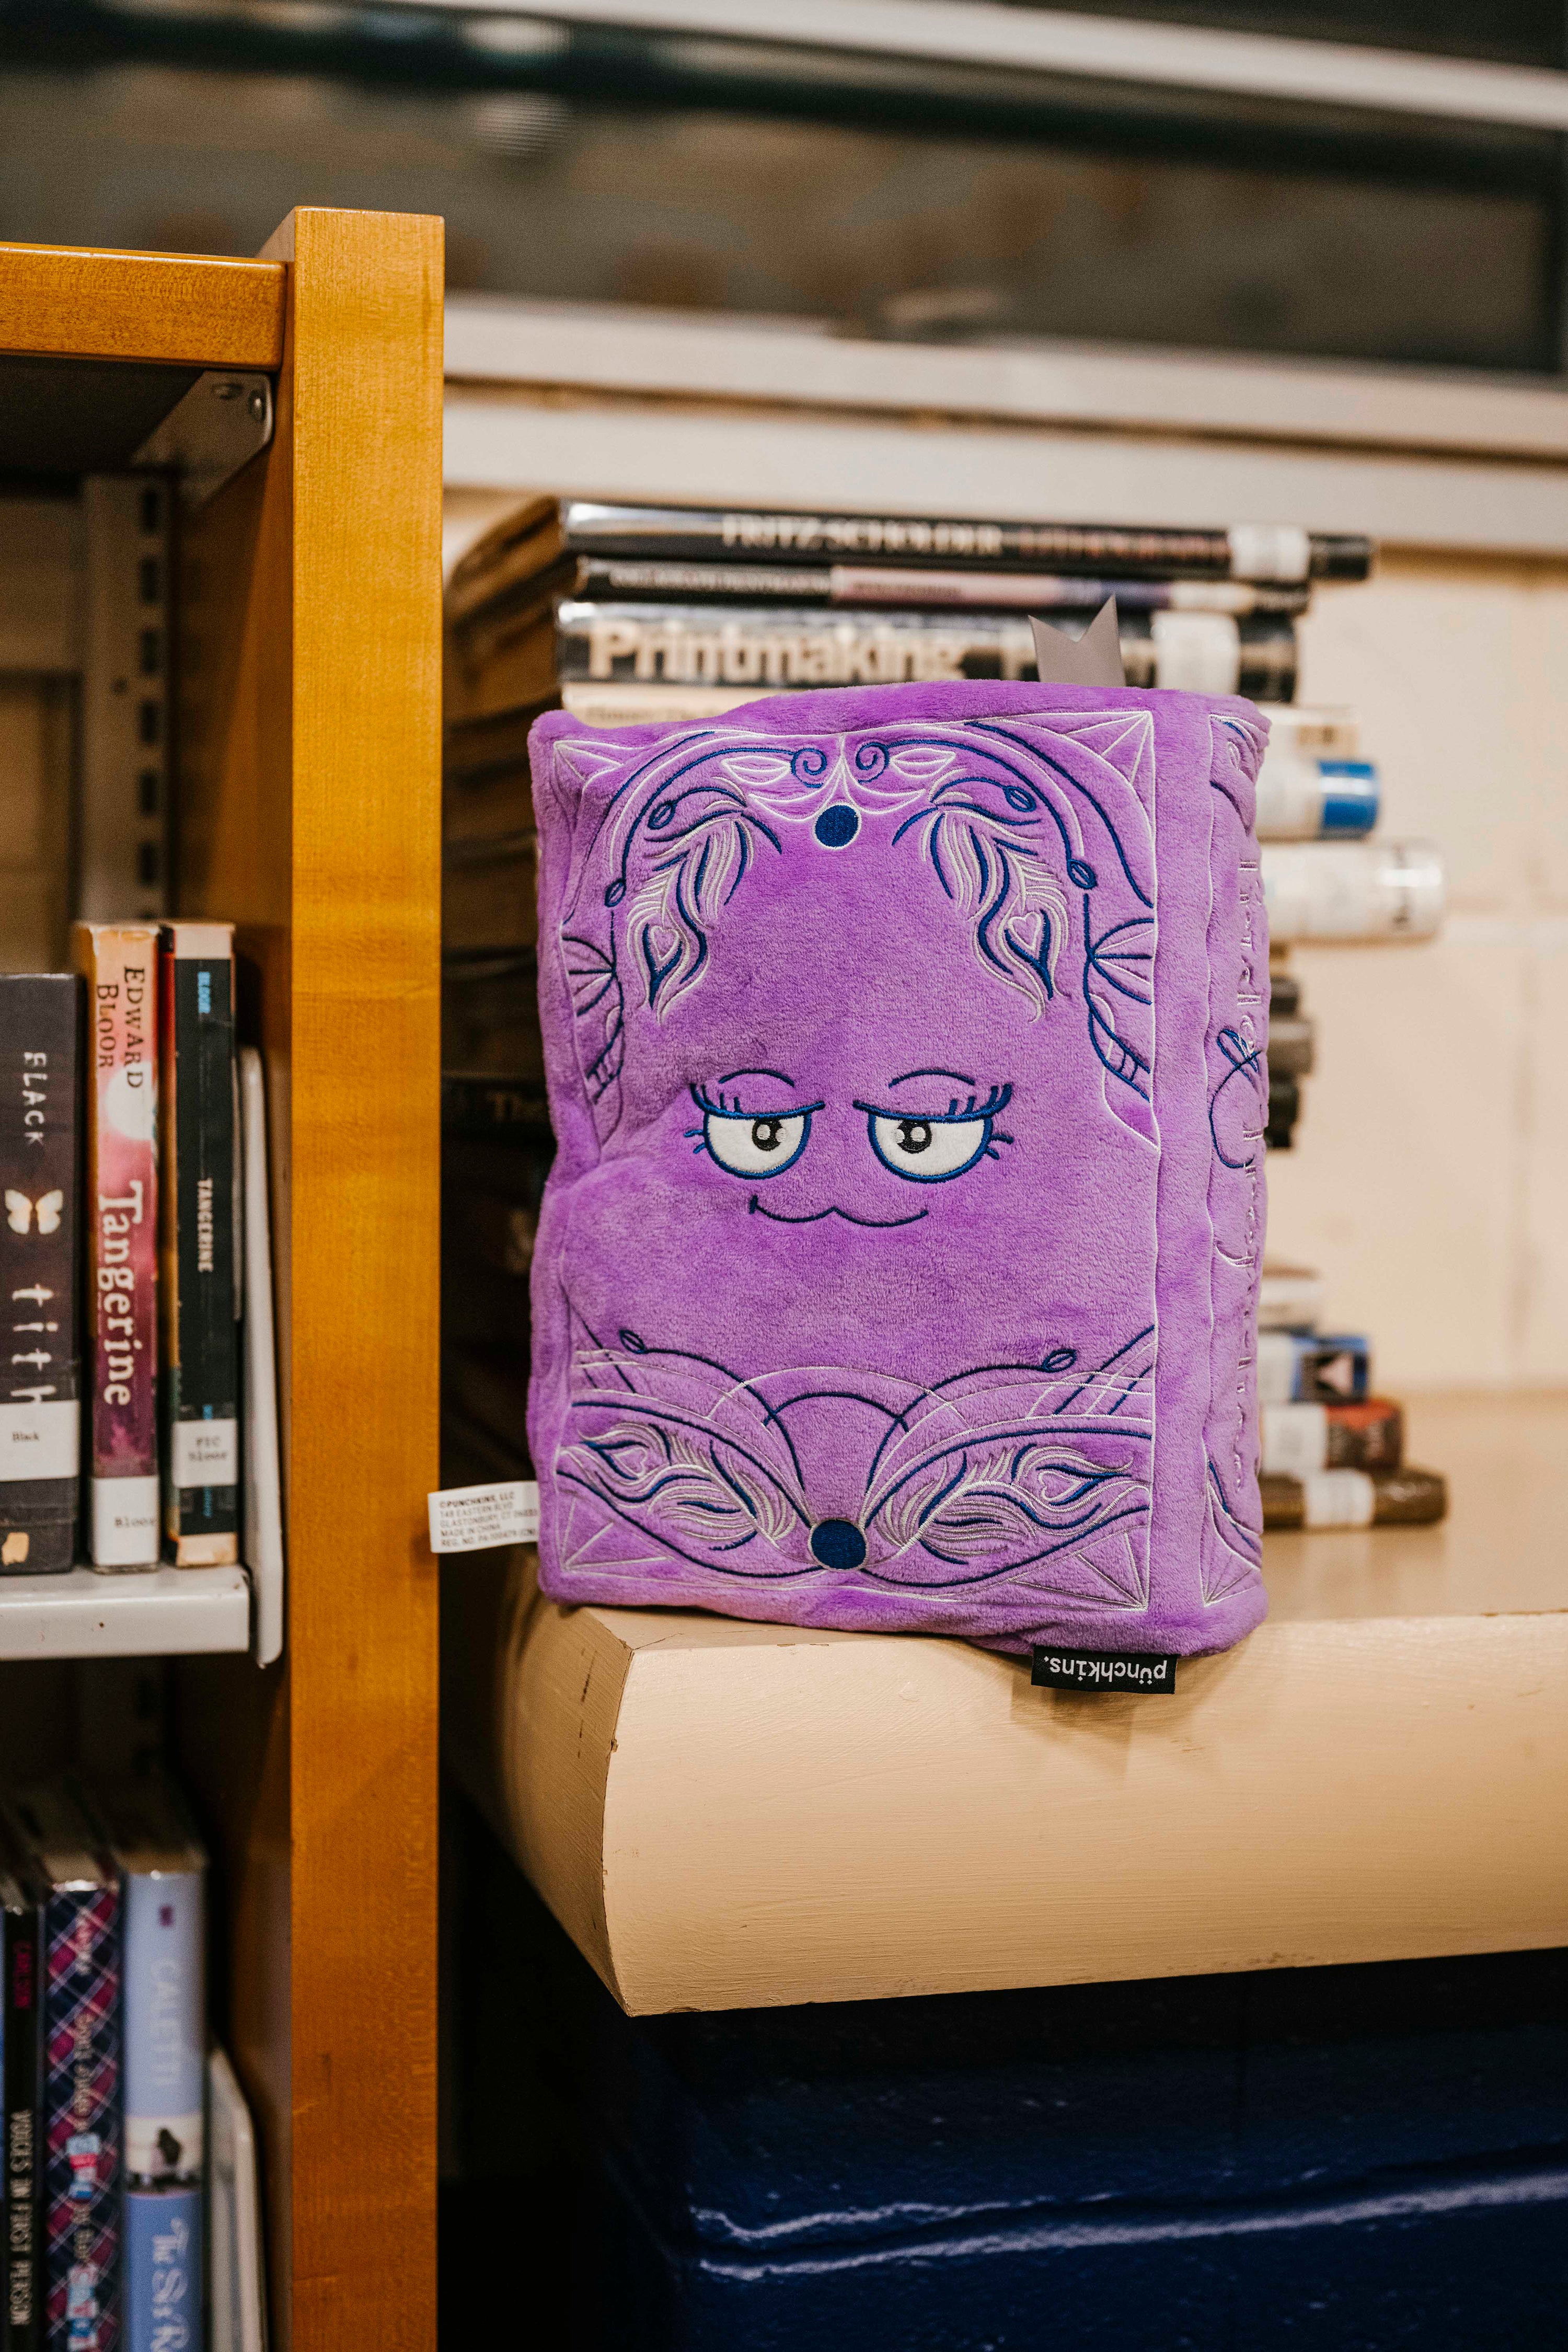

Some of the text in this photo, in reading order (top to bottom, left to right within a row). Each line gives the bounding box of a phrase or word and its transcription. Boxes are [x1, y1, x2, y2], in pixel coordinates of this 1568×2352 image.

[98, 983, 118, 1068] BLOOR
[123, 966, 145, 1088] EDWARD
[198, 1178, 213, 1272] TANGERINE
[98, 1180, 143, 1406] Tangerine
[12, 1431, 39, 1442] Black
